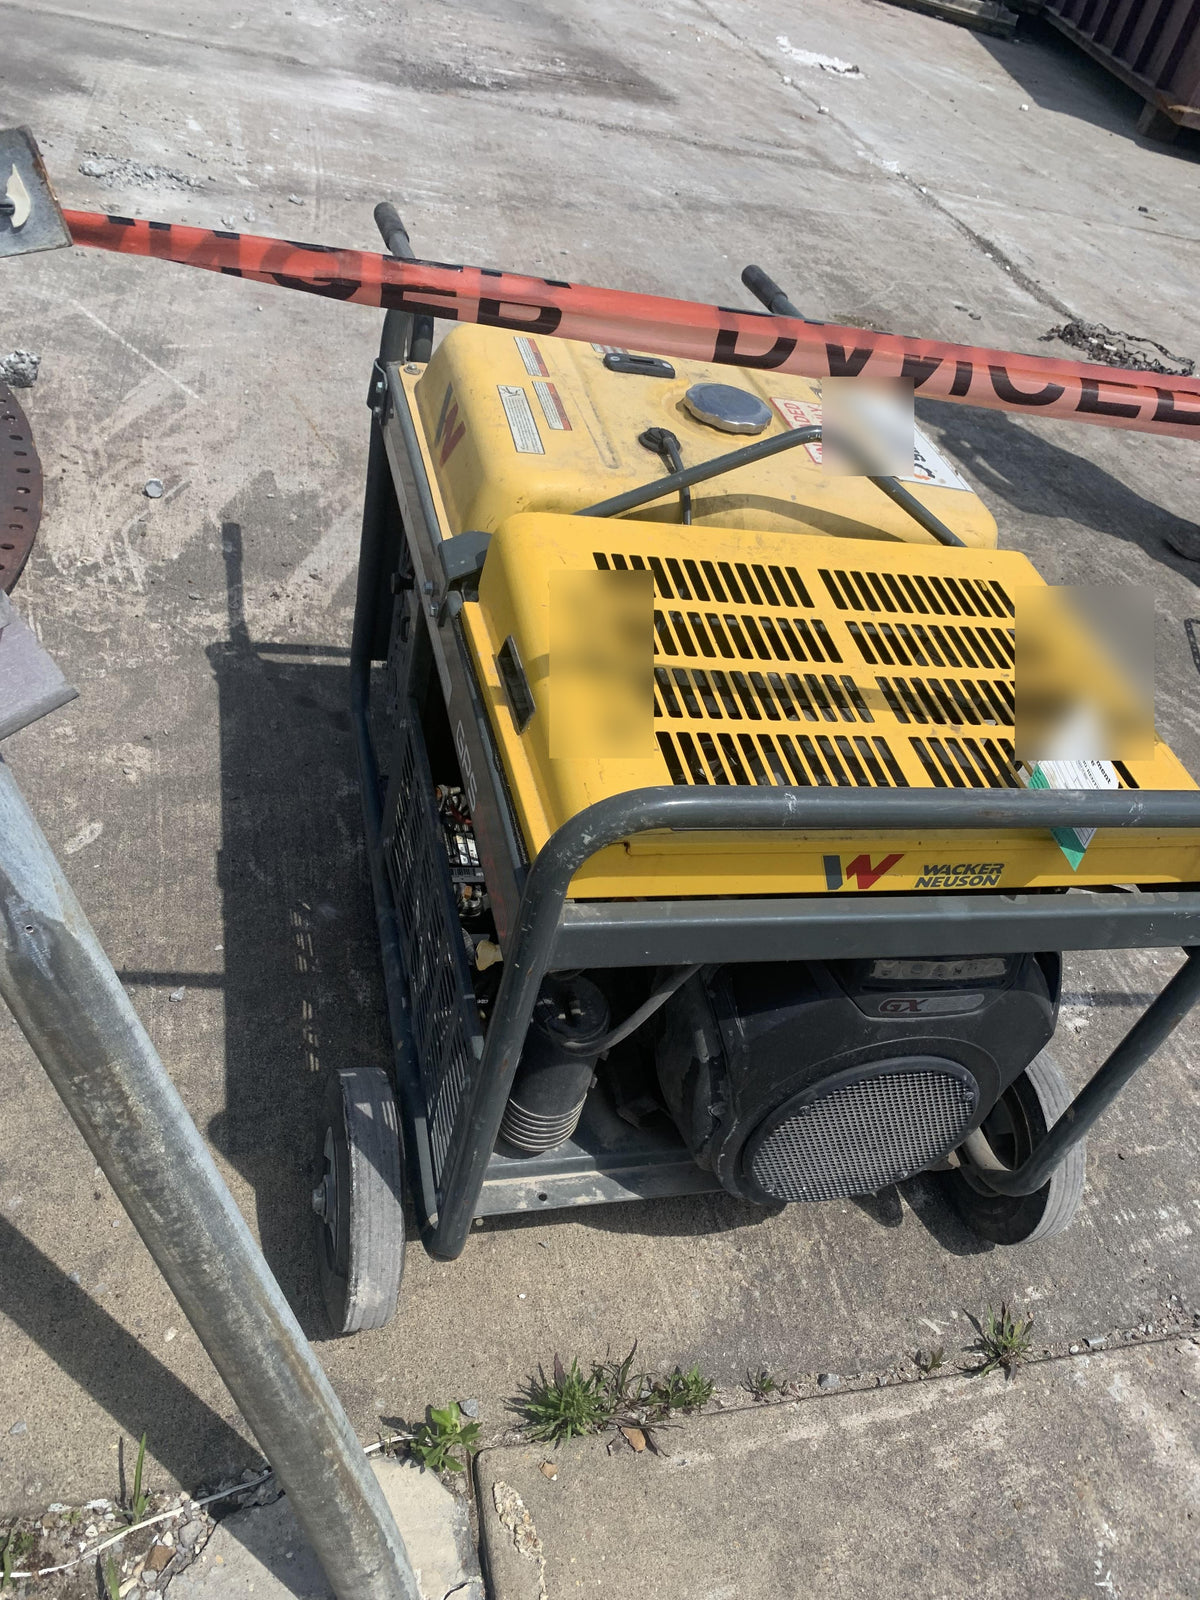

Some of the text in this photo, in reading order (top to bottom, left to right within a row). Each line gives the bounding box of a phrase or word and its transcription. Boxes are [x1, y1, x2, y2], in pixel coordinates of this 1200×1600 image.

[923, 863, 1005, 876] WACKER
[914, 874, 1000, 889] NEUSON
[880, 998, 928, 1013] GX
